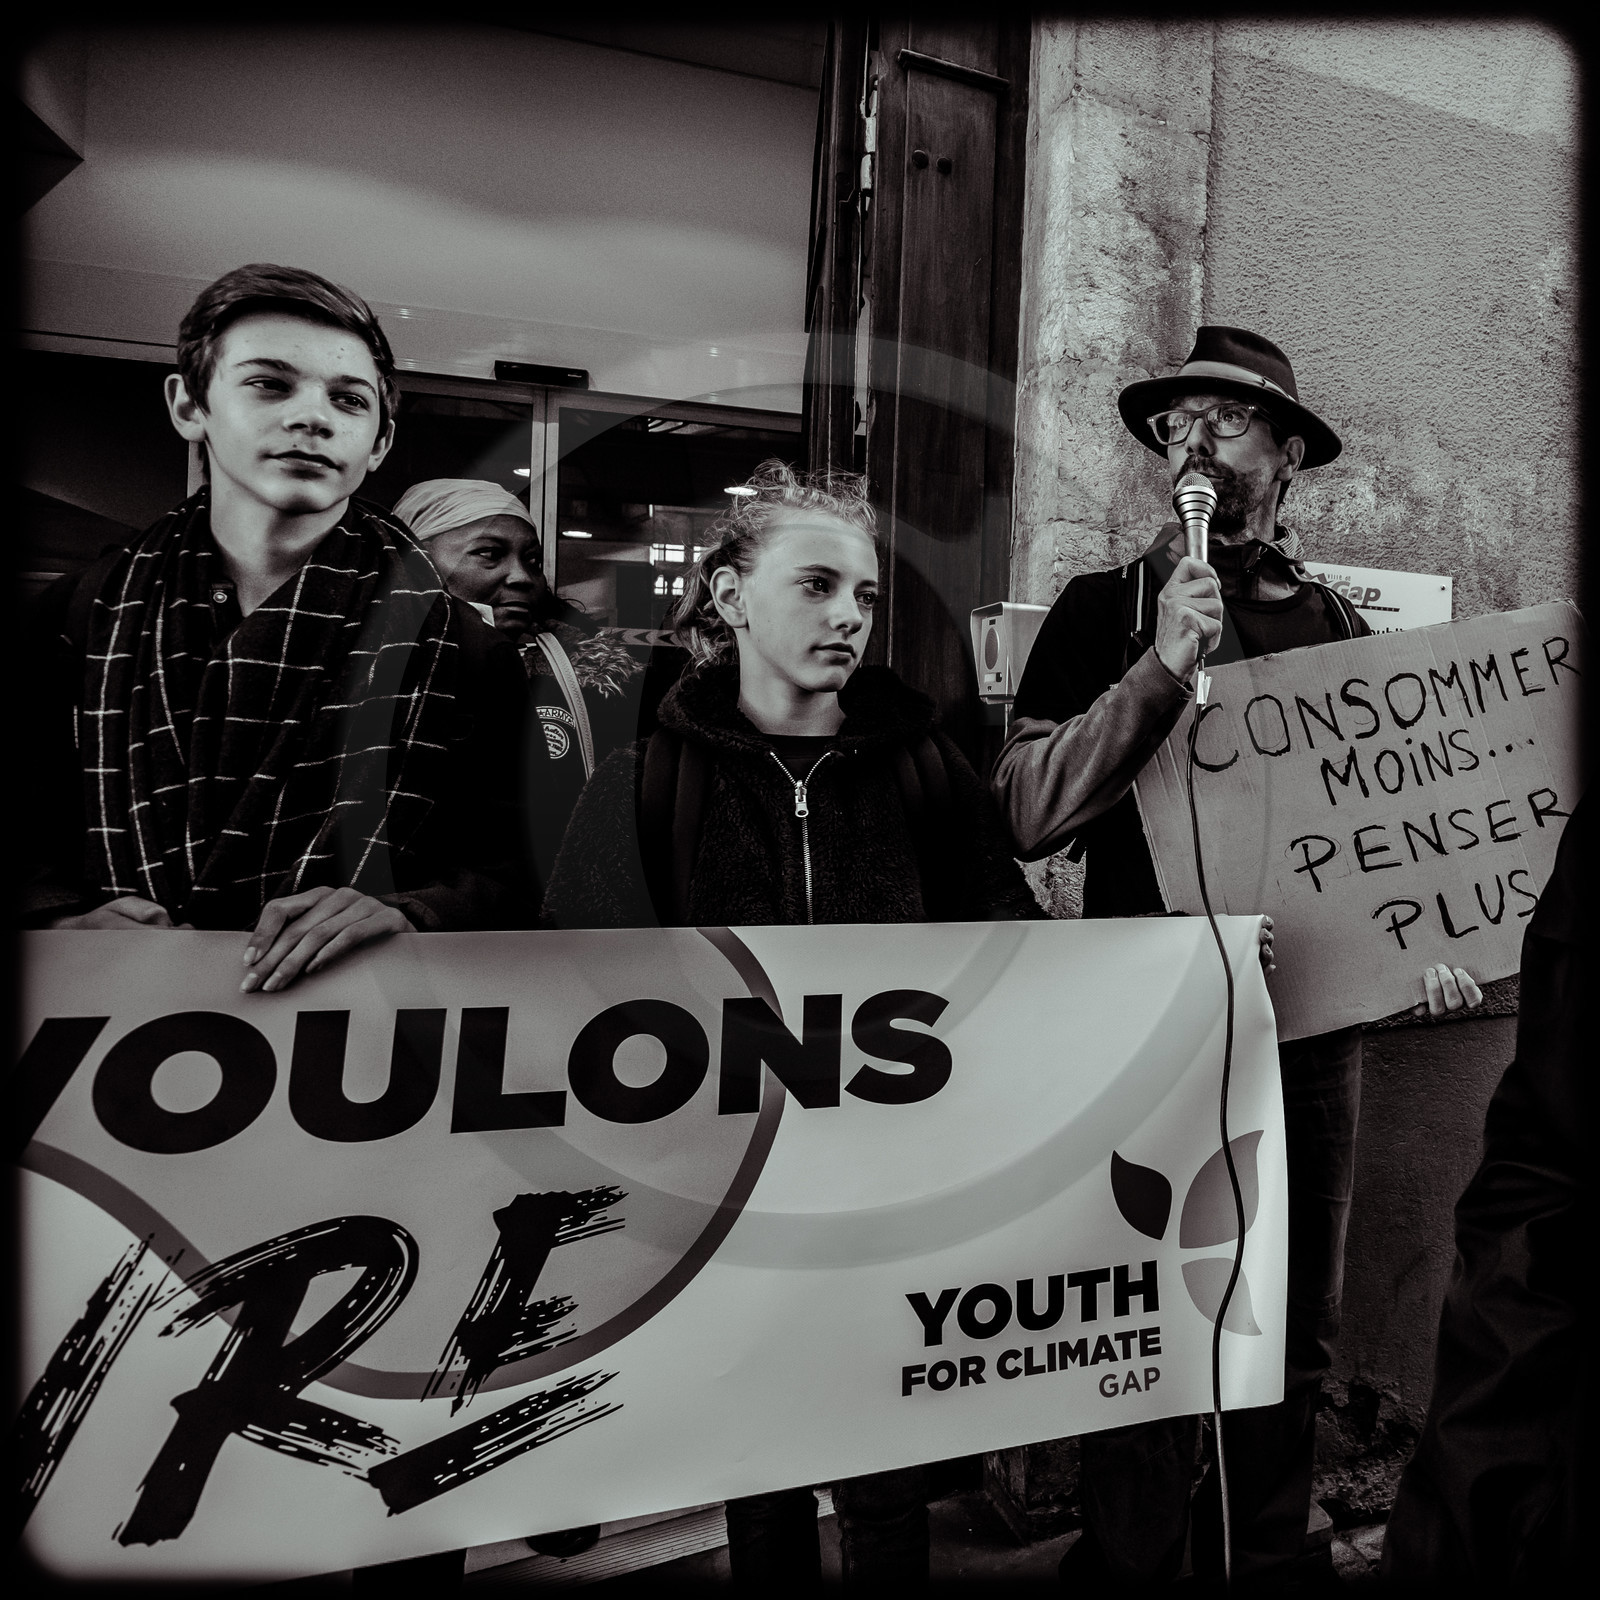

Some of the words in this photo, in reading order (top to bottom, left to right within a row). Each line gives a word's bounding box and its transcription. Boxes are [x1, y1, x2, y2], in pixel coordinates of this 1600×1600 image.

[1331, 580, 1382, 606] Gap
[1187, 636, 1582, 773] CONSOMMER
[1287, 787, 1573, 893] PENSER
[1371, 868, 1539, 950] PLUS
[904, 1259, 1161, 1348] YOUTH
[901, 1355, 987, 1397] FOR
[996, 1326, 1163, 1380] CLIMATE
[1099, 1366, 1162, 1399] GAP
